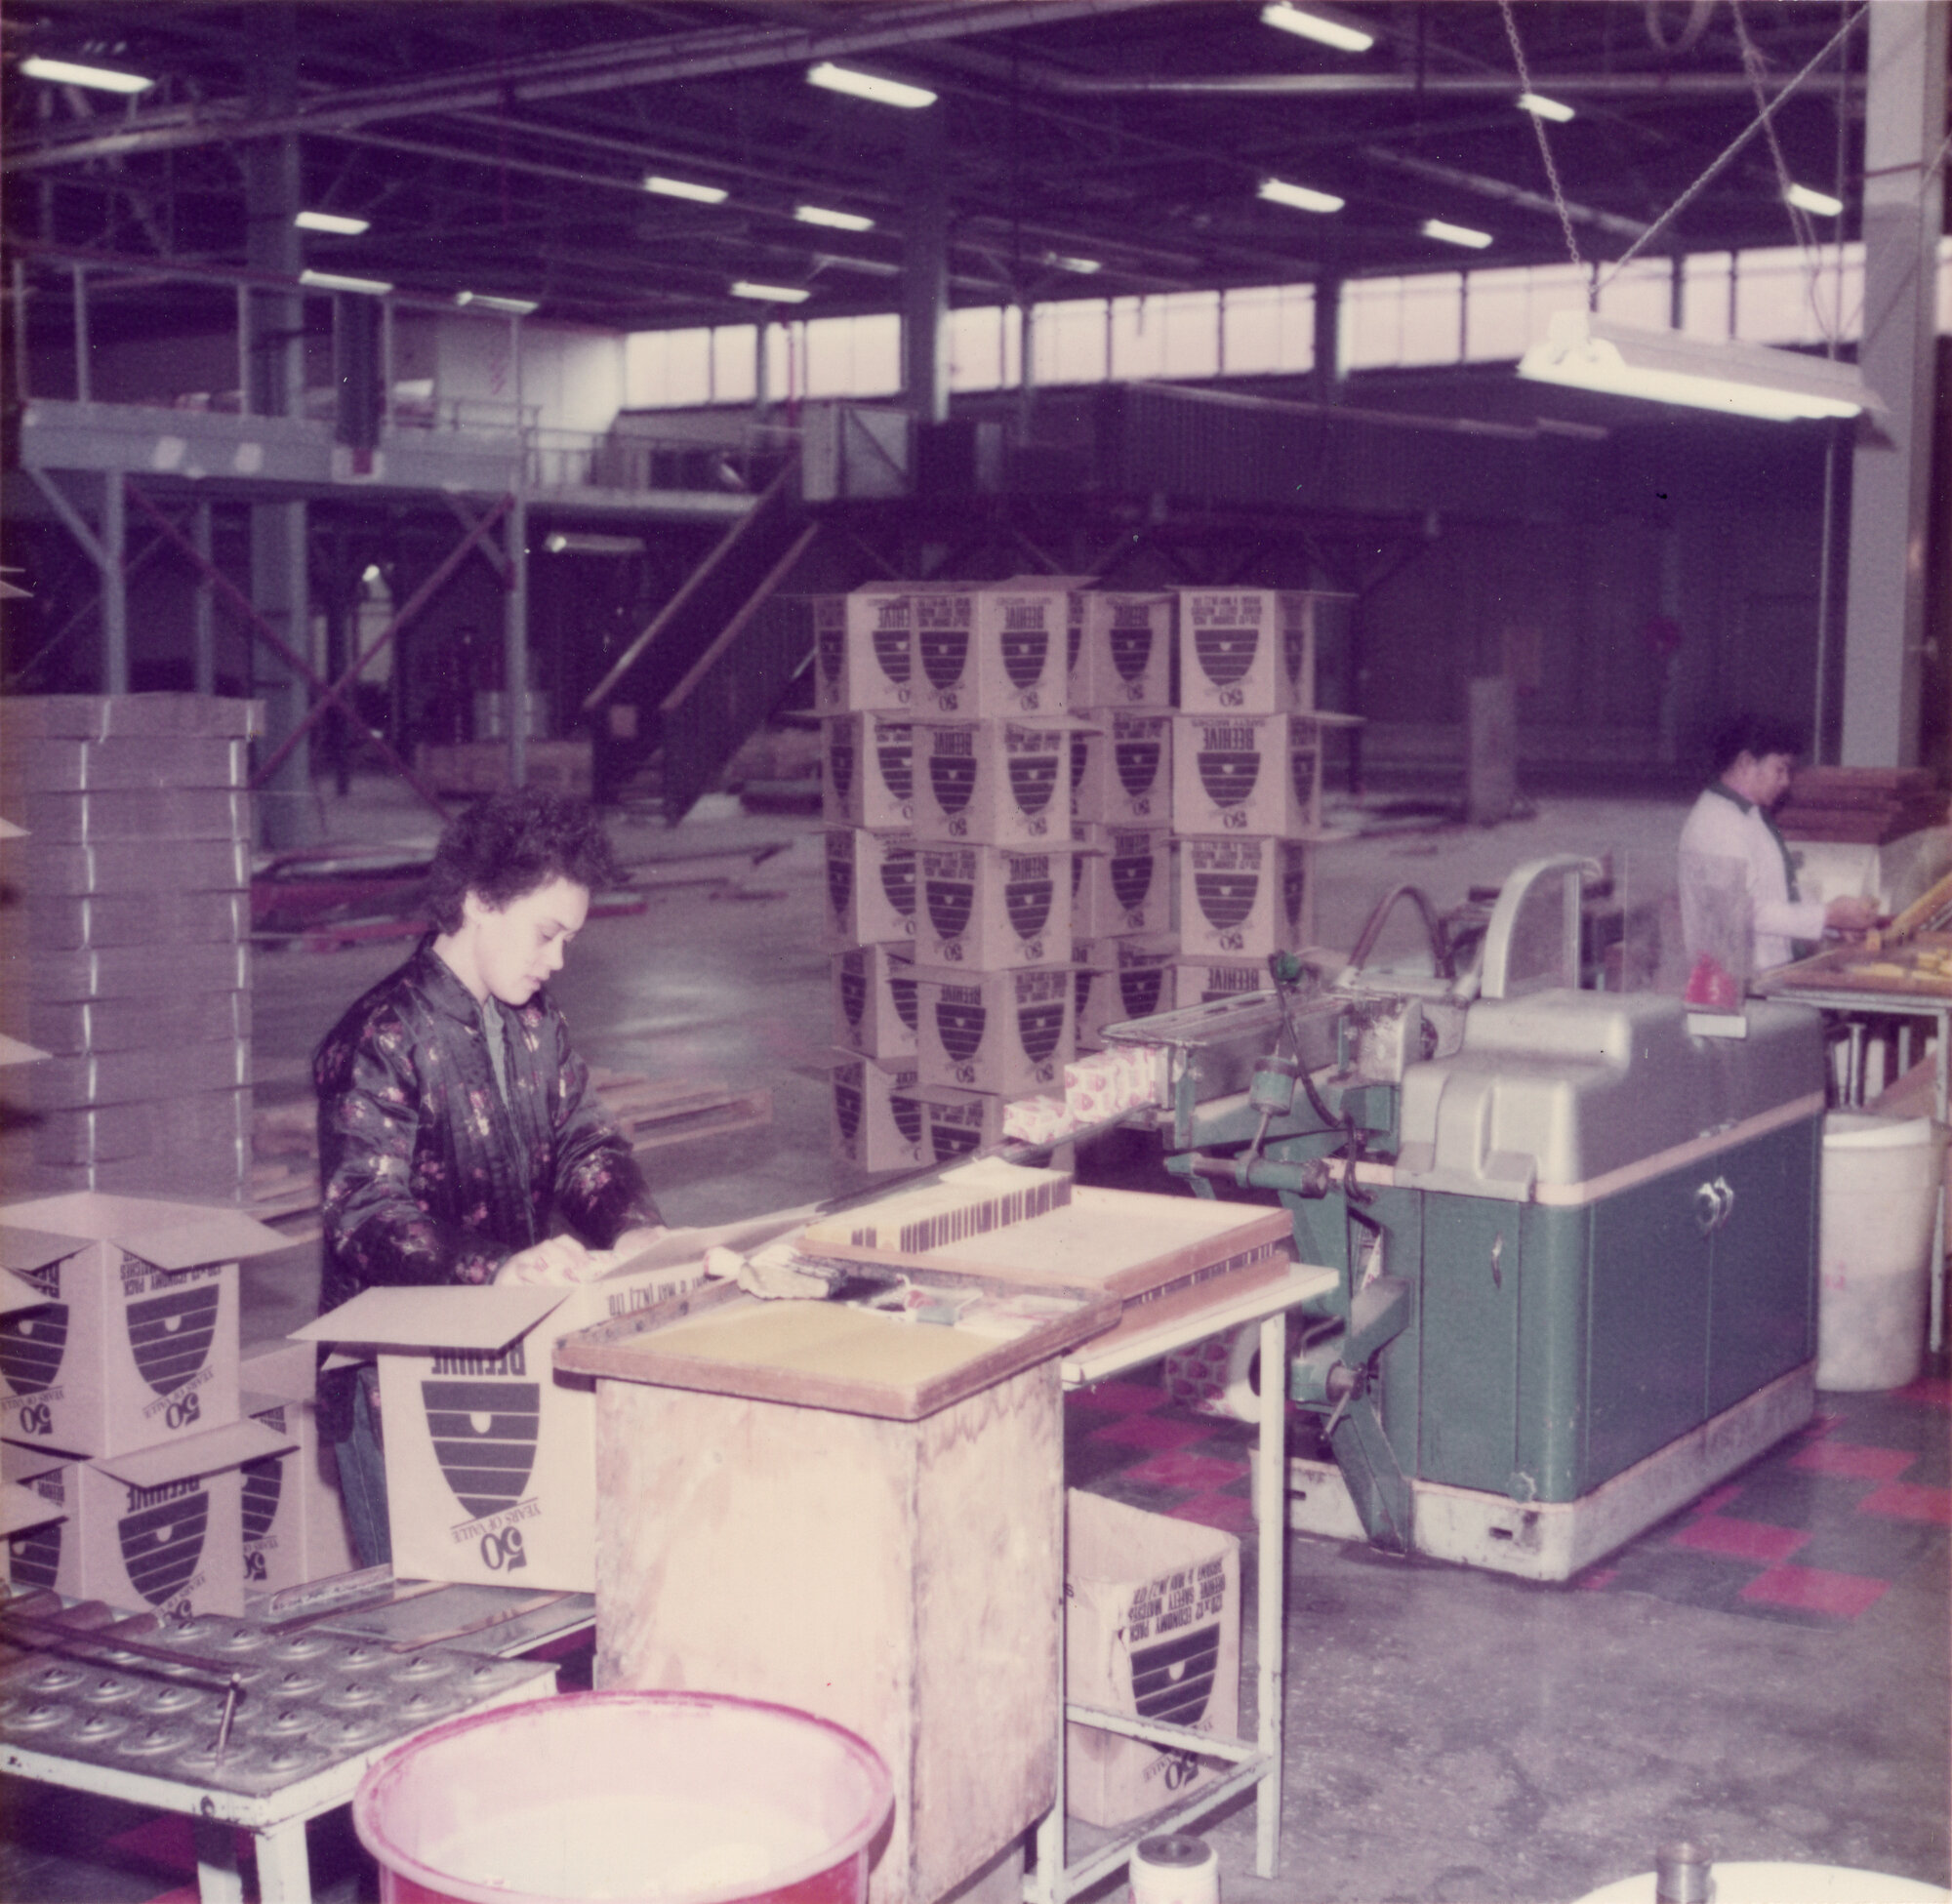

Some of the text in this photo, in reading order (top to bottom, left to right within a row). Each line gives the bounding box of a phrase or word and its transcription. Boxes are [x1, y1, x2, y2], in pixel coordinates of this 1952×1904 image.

[1219, 689, 1244, 708] 50
[1203, 727, 1255, 750] BEEHIVE
[949, 818, 968, 836] 50
[1028, 818, 1048, 836] 50
[1223, 810, 1248, 830] 50
[944, 943, 964, 961] 50
[1025, 941, 1044, 960] 50
[1219, 933, 1244, 951] 50
[1208, 968, 1260, 992] BEEHIVE
[956, 1065, 976, 1084] 50
[20, 1403, 54, 1436] 50
[165, 1393, 202, 1431] 50
[451, 1503, 542, 1545] YEARS OF VALUE
[479, 1526, 528, 1574] 50
[1168, 1587, 1196, 1611] SAFETY
[1129, 1621, 1150, 1643] PACK
[1156, 1606, 1192, 1636] ECONOMY
[1165, 1752, 1200, 1792] 50
